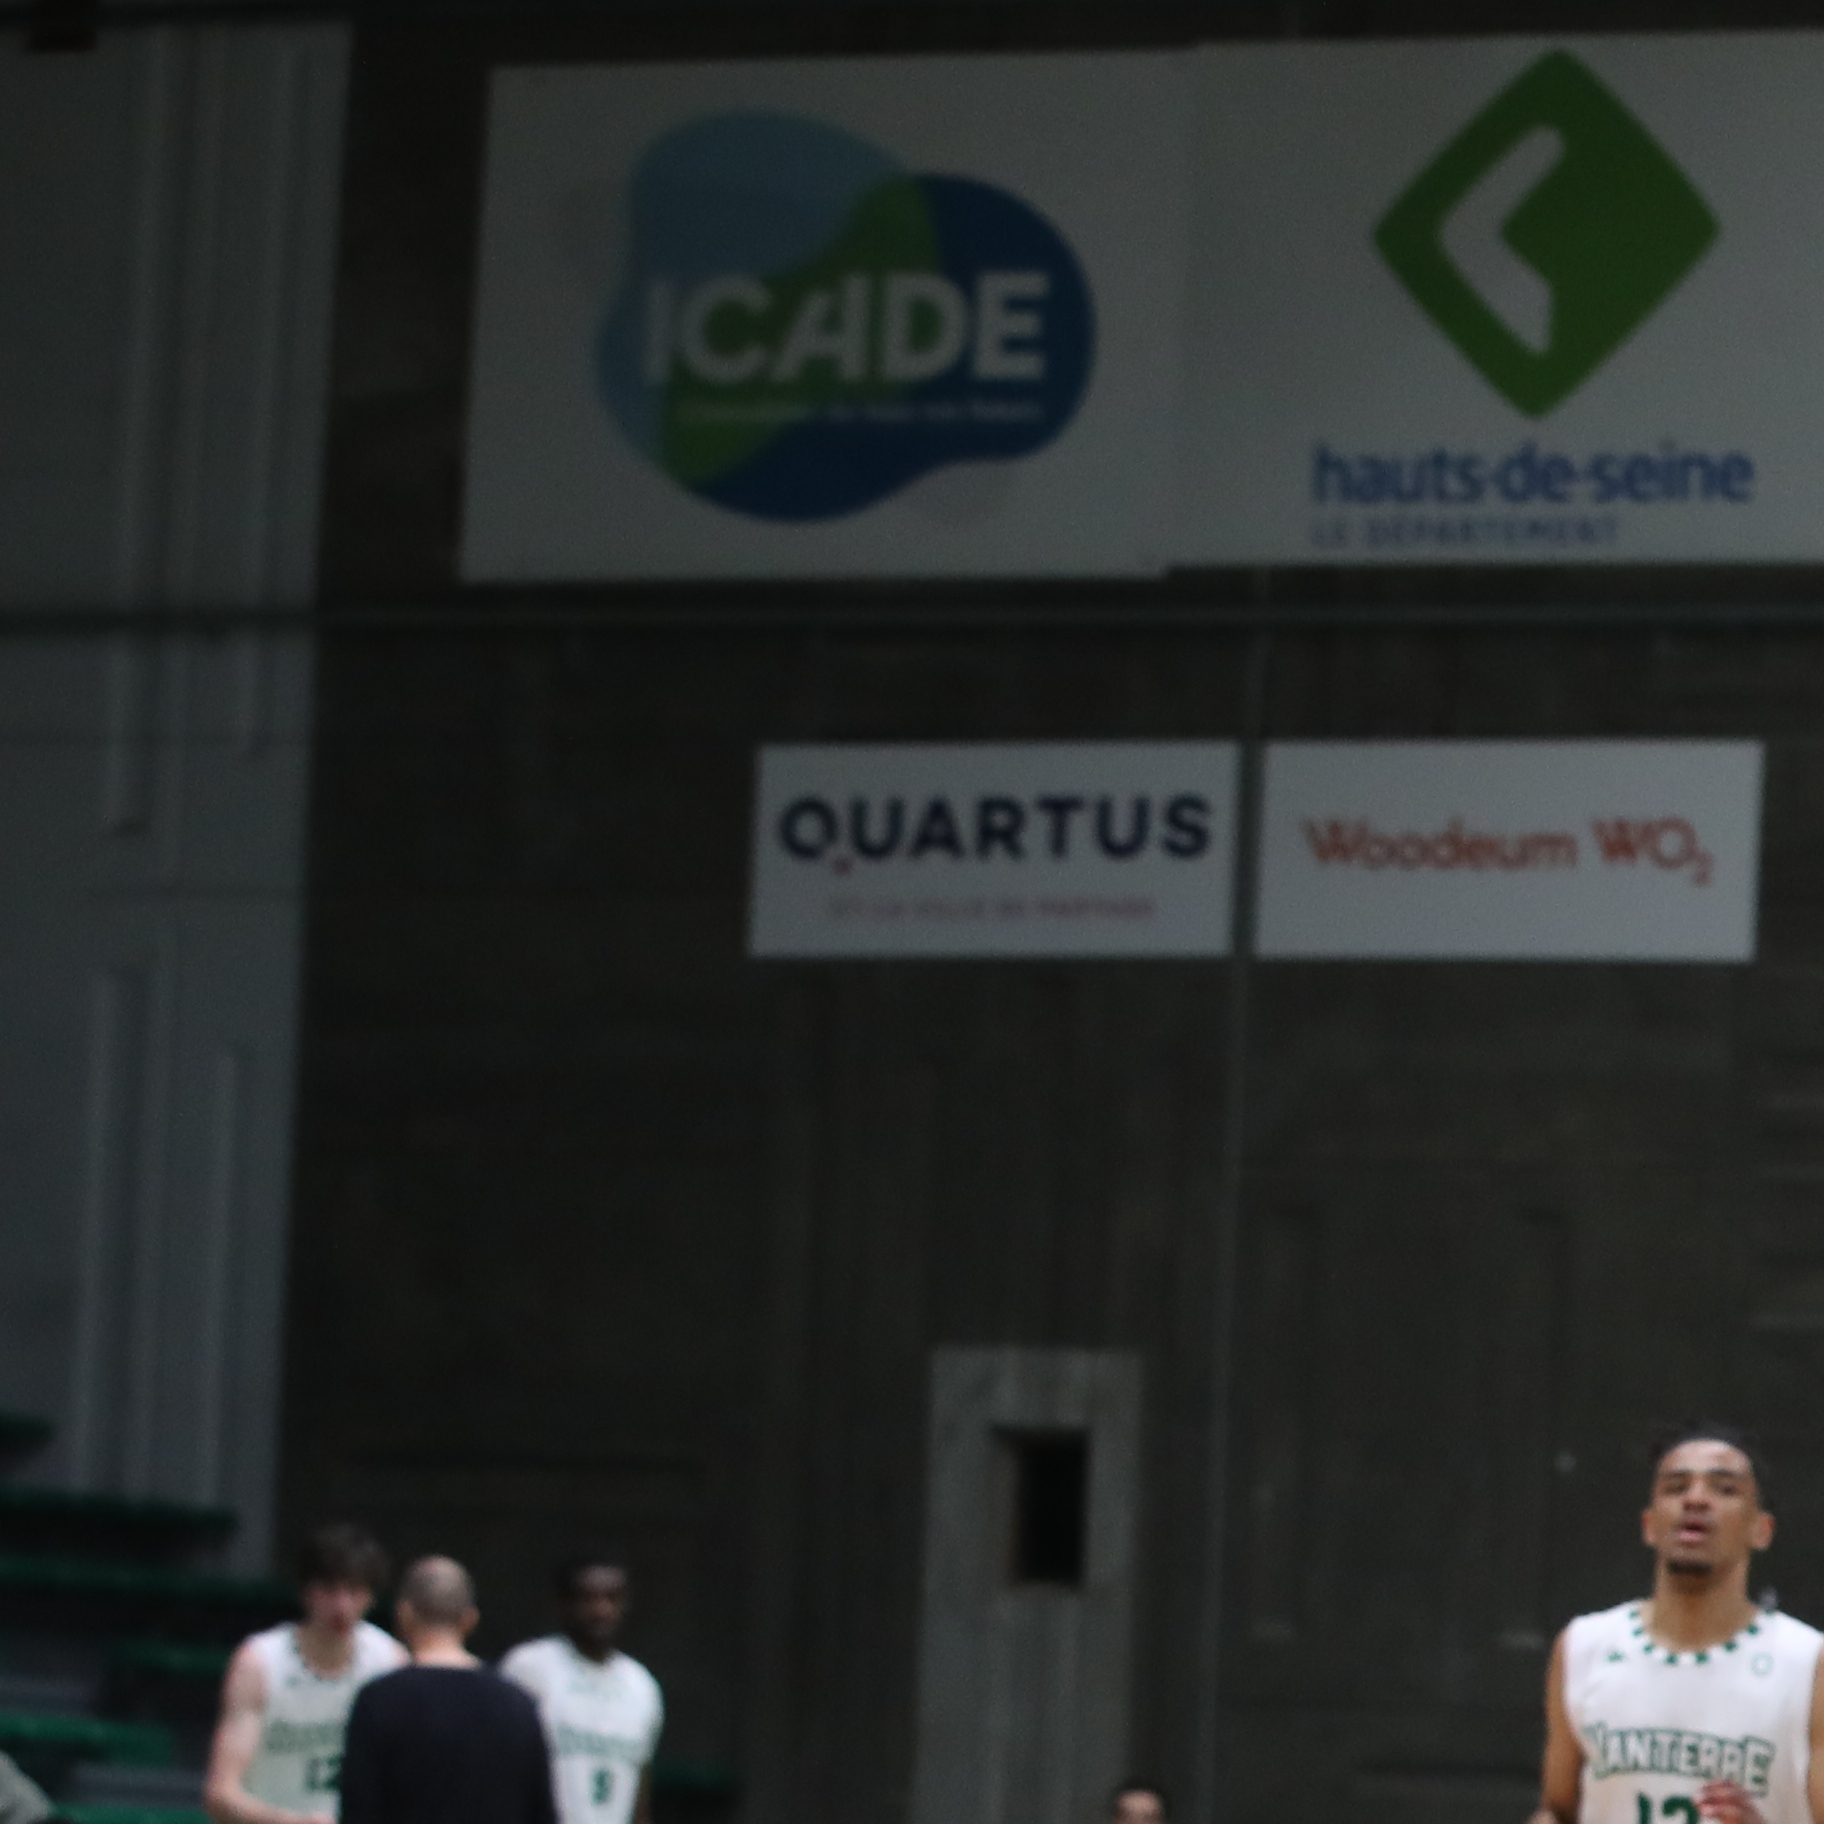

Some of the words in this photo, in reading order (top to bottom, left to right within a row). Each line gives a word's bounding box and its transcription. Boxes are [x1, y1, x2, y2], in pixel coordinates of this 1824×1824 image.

[642, 270, 1050, 385] ICADE
[777, 794, 1212, 864] QUARTUS
[1303, 817, 1579, 868] Woodeum
